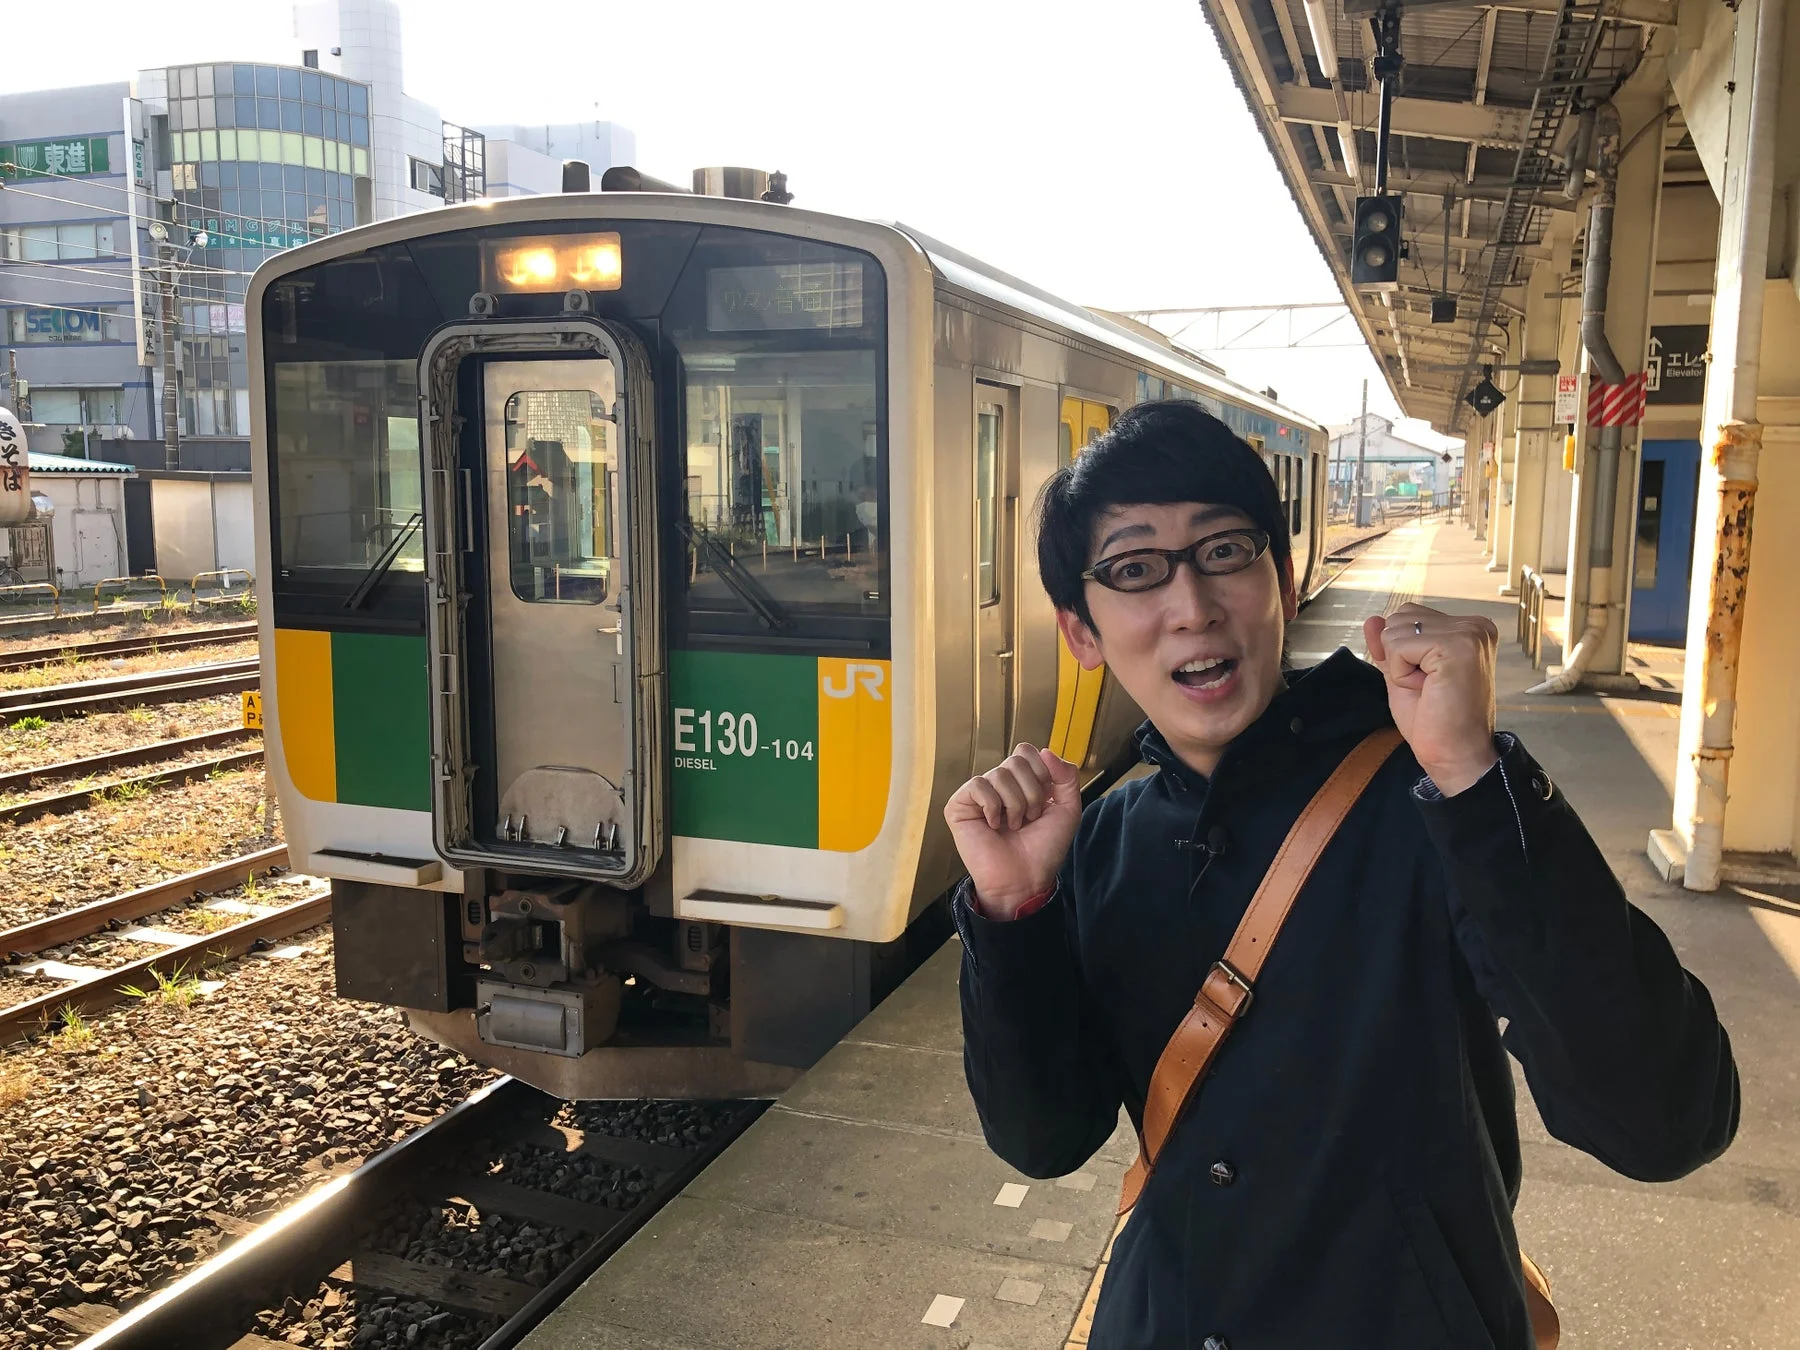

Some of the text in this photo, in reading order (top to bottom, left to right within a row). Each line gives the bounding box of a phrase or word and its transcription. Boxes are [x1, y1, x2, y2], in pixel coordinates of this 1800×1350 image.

[44, 141, 86, 174] 東進
[27, 307, 100, 333] SECOM
[1667, 352, 1700, 367] エレ
[1666, 368, 1702, 378] Elevator
[823, 663, 884, 700] JR
[674, 757, 717, 770] DIESEL
